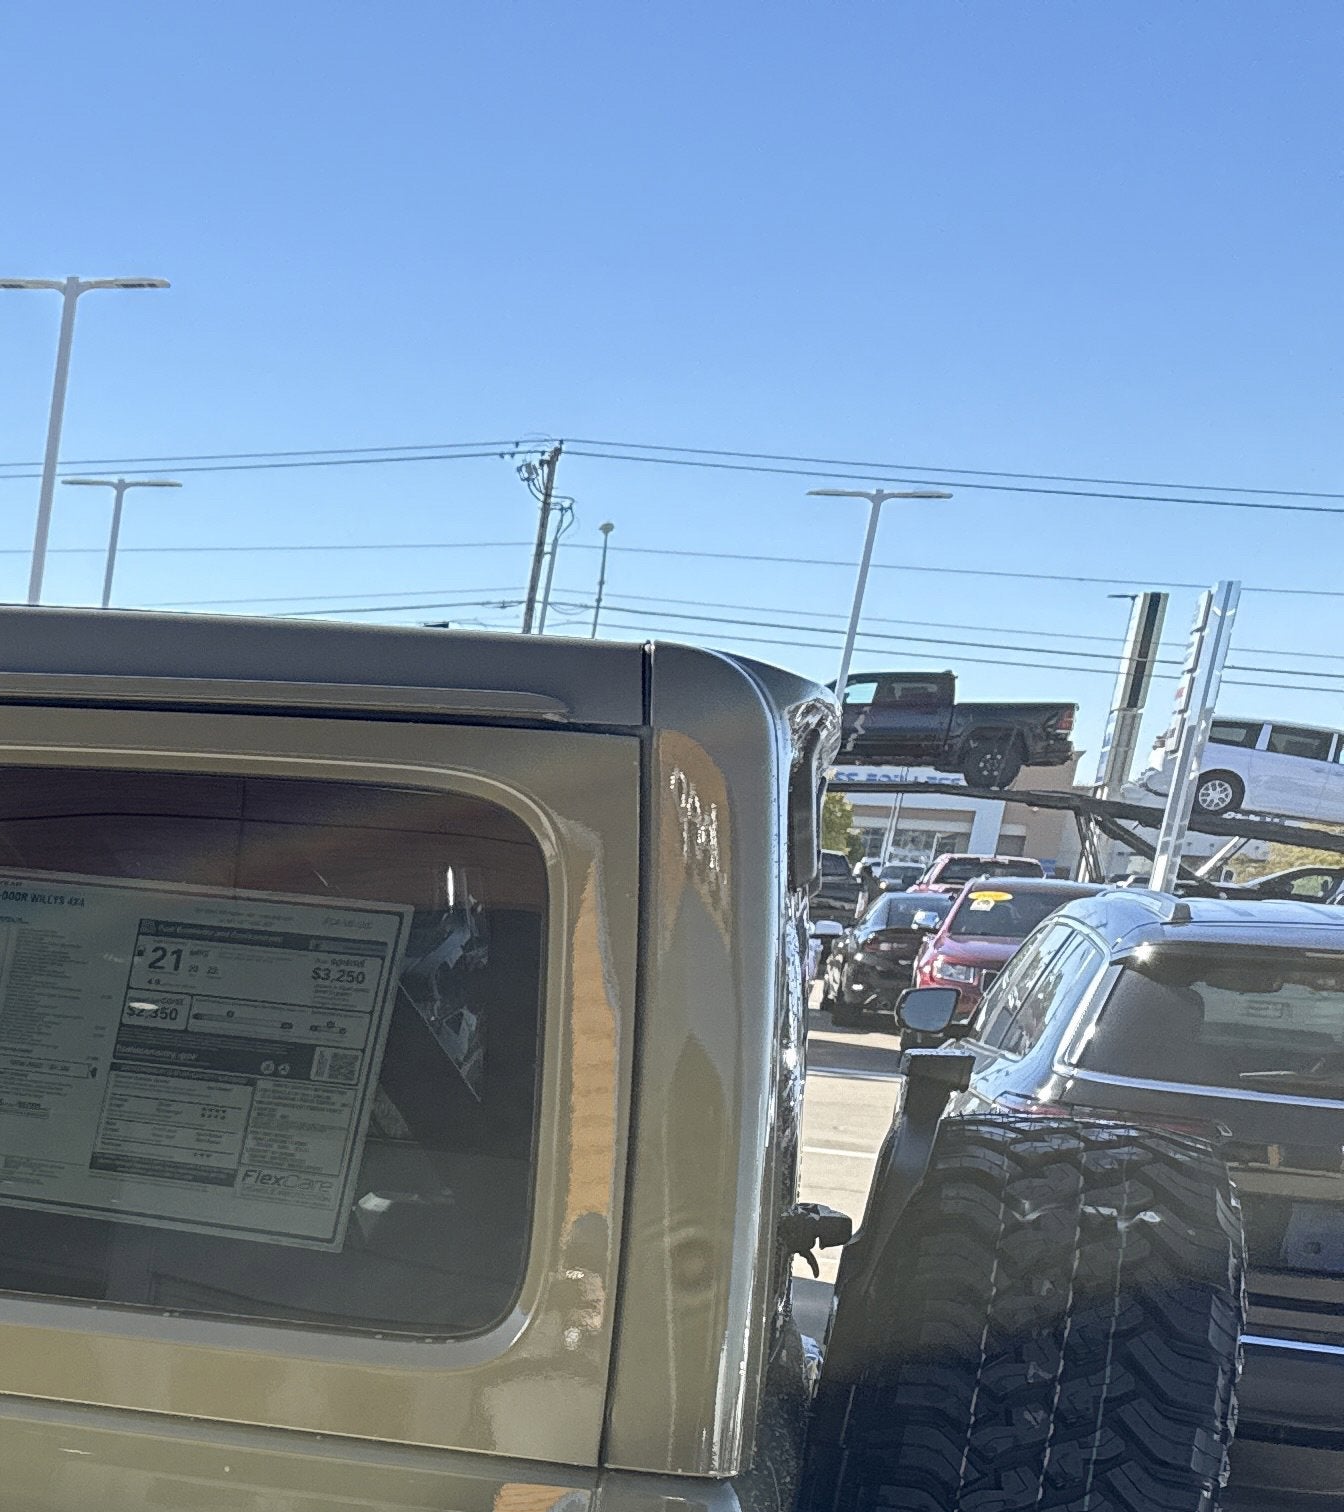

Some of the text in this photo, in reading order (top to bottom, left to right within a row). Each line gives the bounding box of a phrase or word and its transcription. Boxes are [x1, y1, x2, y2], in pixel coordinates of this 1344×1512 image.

[147, 946, 183, 972] 21
[311, 967, 366, 985] $3,250
[242, 1169, 332, 1191] FlexCare
